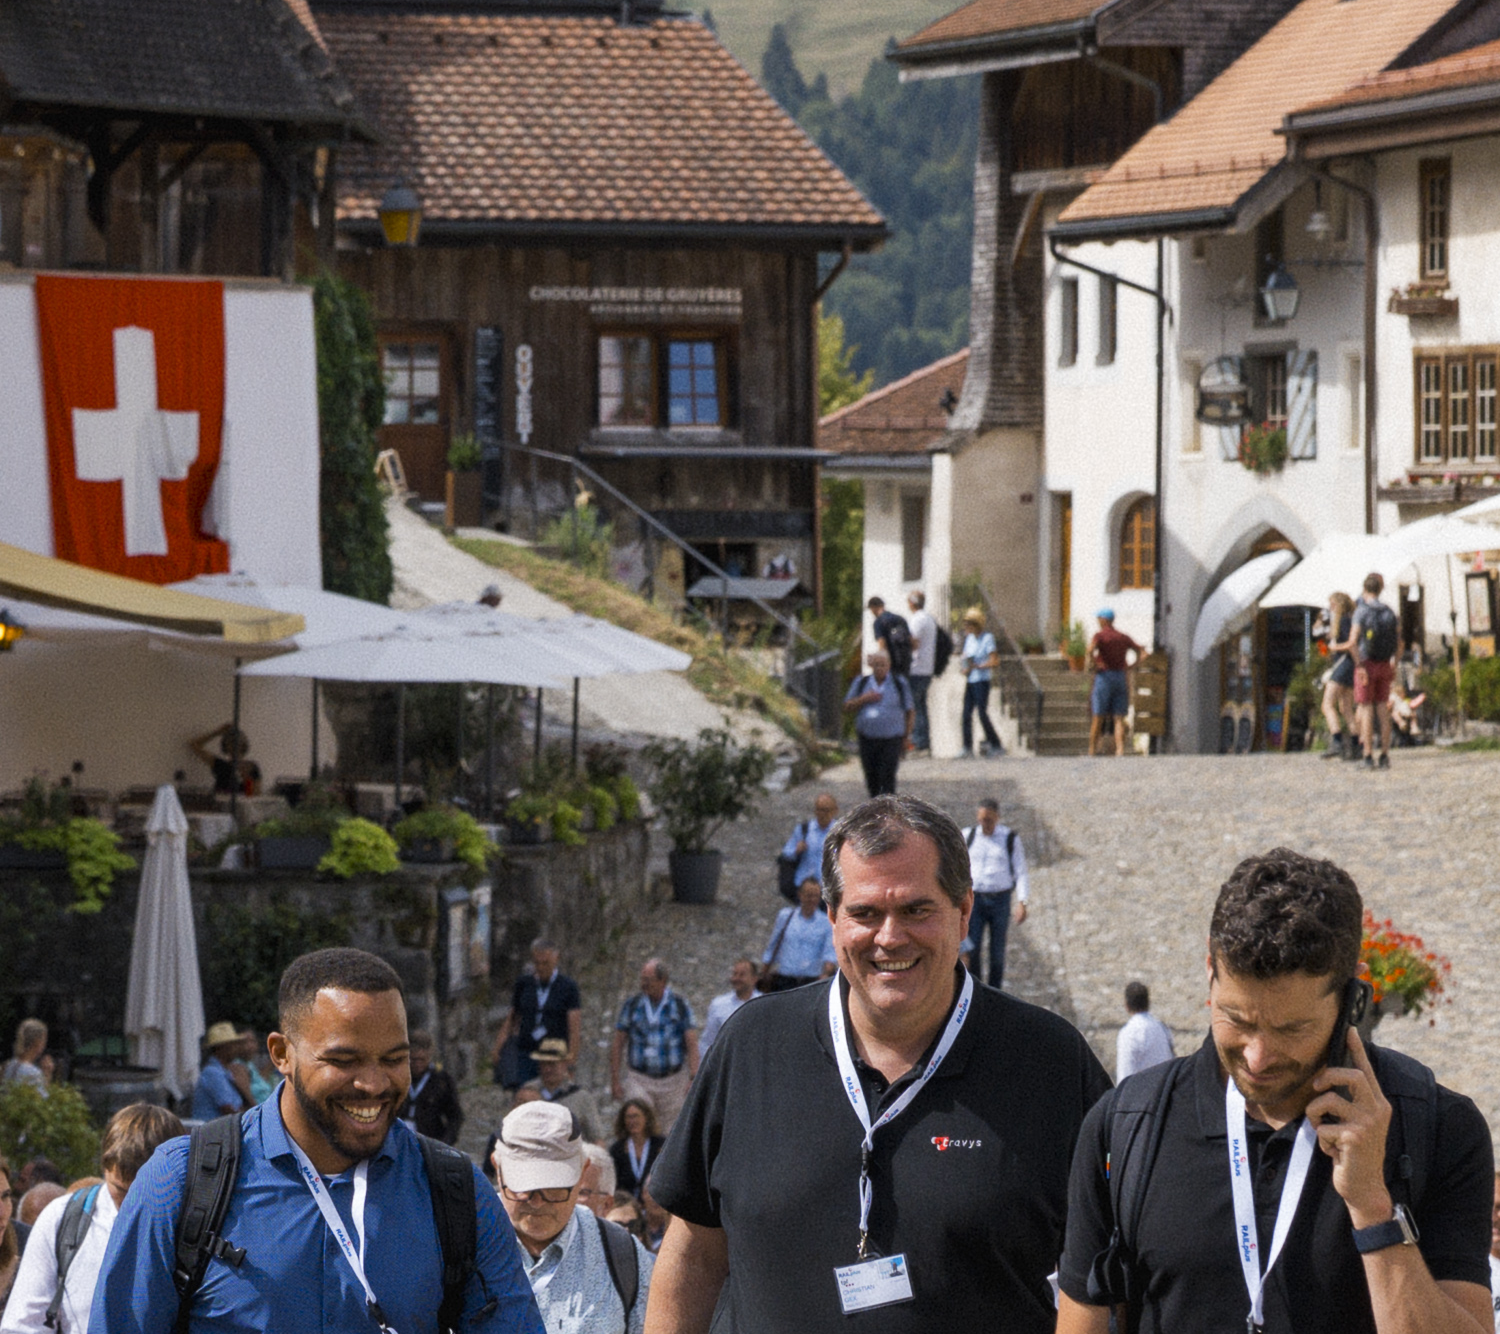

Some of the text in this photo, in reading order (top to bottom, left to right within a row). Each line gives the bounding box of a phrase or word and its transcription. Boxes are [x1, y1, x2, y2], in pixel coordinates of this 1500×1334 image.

[529, 285, 743, 303] CHOCOLATERIE DE GRUYÈRES
[943, 1136, 982, 1149] travys
